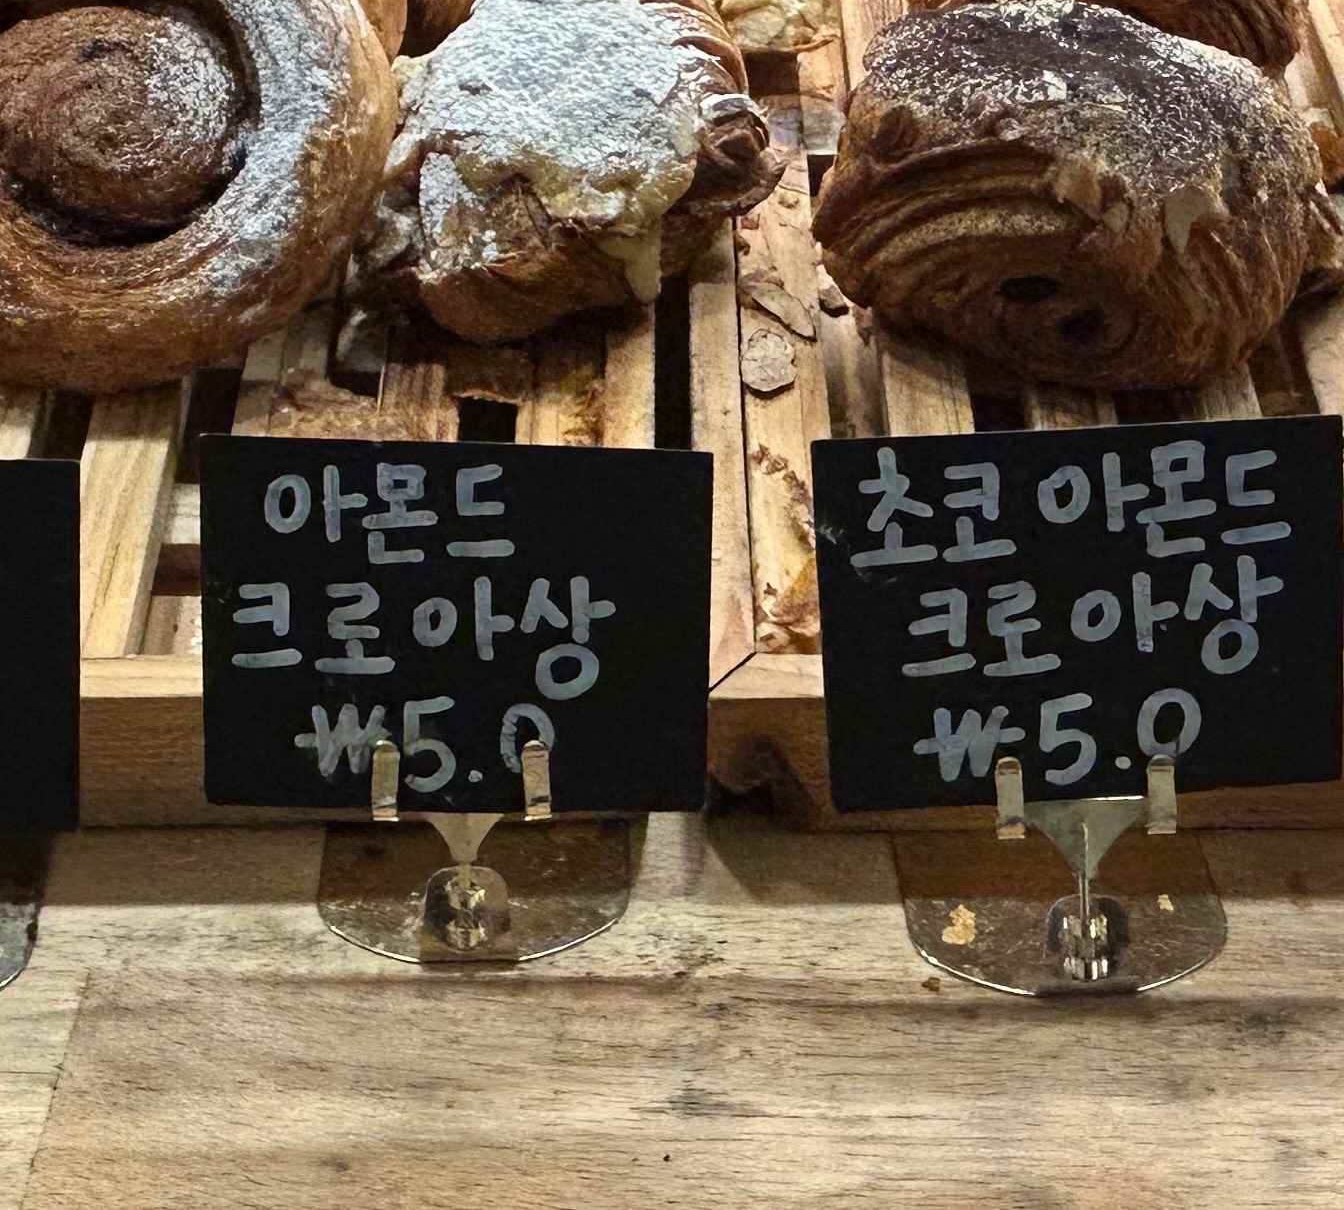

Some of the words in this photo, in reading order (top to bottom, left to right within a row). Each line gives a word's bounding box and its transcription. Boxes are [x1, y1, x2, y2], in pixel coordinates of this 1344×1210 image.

[264, 462, 515, 565] 아몬드
[231, 576, 617, 700] 크로아상
[902, 555, 1285, 675] 크로아상
